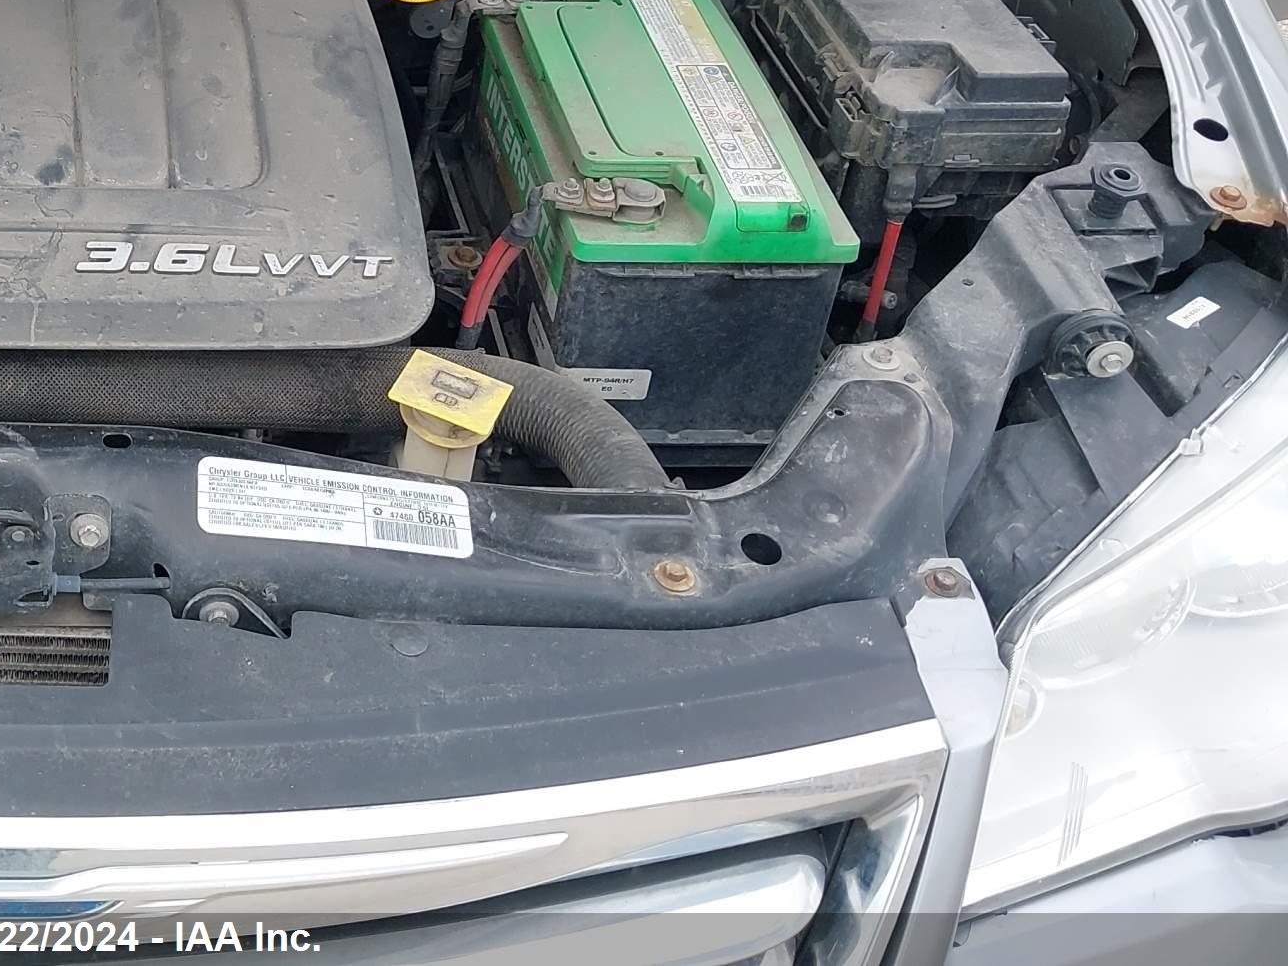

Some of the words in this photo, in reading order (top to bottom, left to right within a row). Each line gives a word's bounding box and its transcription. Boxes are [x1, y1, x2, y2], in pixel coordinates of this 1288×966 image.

[75, 241, 261, 274] 3.6L
[263, 252, 393, 278] VVT
[209, 467, 241, 477] Chrysler
[244, 470, 268, 481] Group
[270, 473, 285, 482] LLC
[288, 475, 320, 486] VEHICLE
[323, 479, 360, 491] EMISSION
[362, 485, 396, 496] CONTROL
[400, 489, 454, 503] INFORMATION
[418, 509, 457, 528] 058AA
